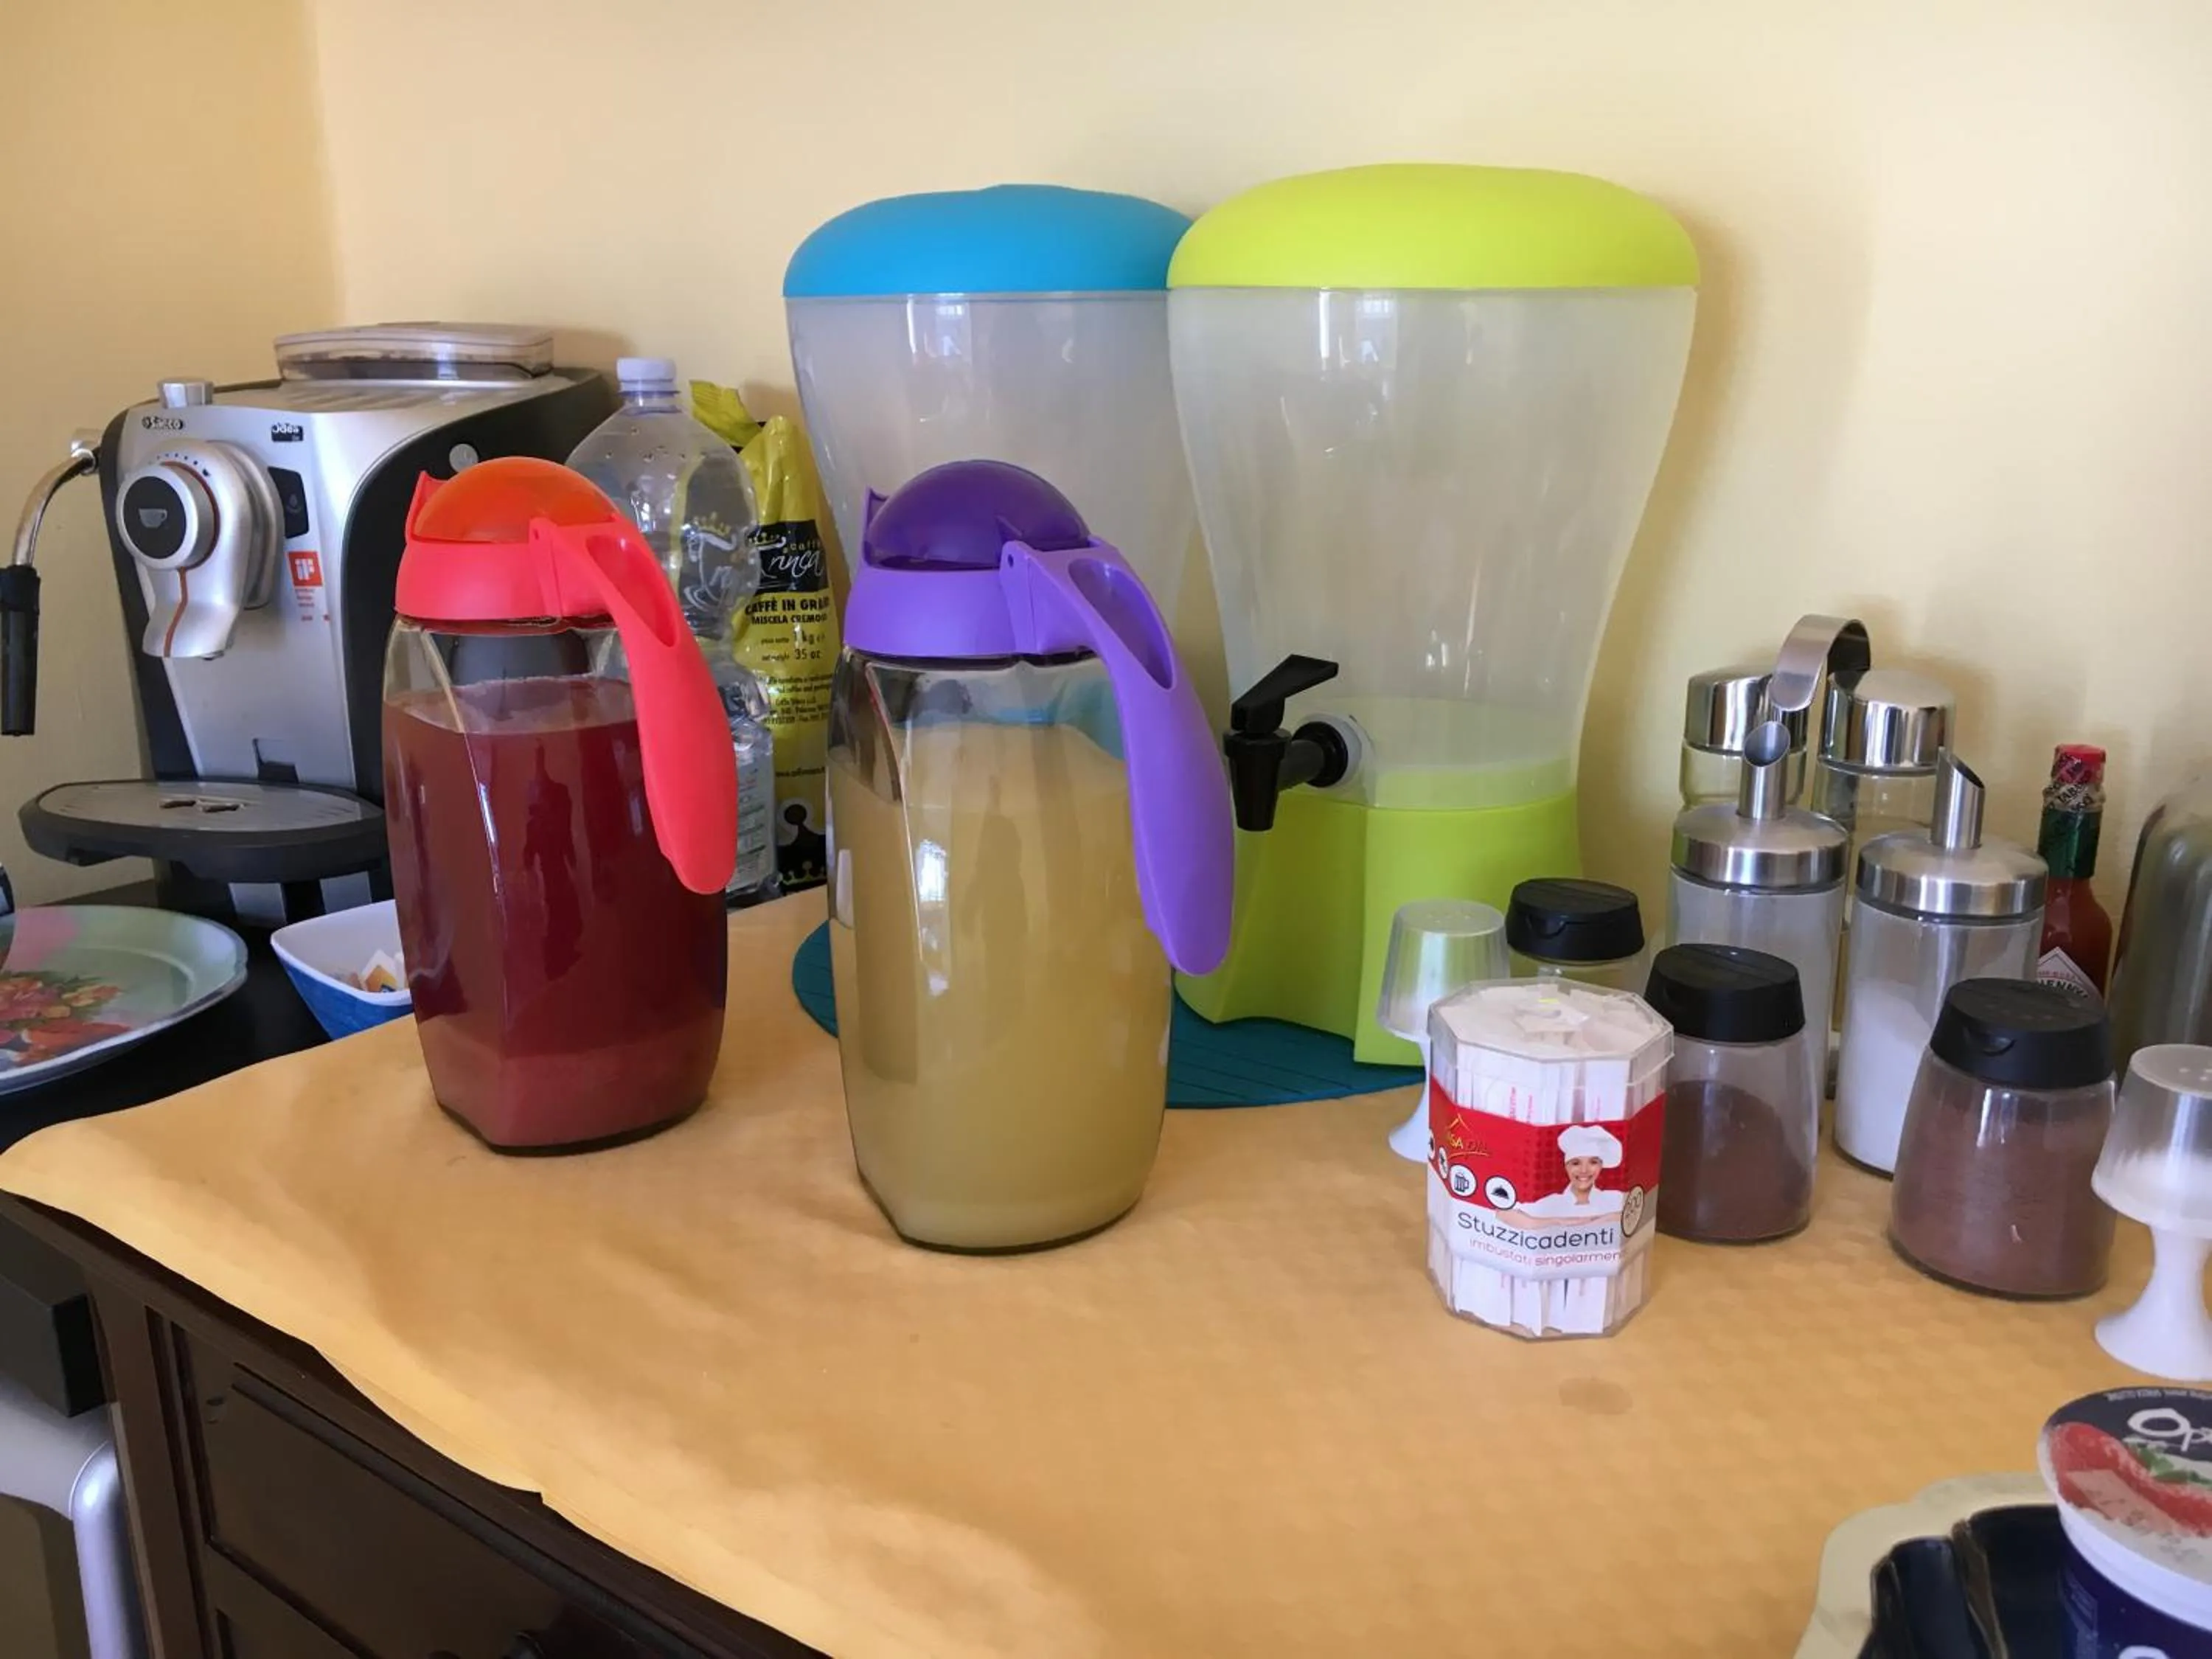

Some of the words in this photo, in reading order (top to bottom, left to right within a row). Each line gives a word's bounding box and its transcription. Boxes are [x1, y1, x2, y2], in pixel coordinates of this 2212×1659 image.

[782, 598, 796, 611] IN
[794, 649, 807, 660] 35
[1457, 1211, 1614, 1250] Stuzzicadenti
[1534, 1249, 1624, 1267] singolarmen
